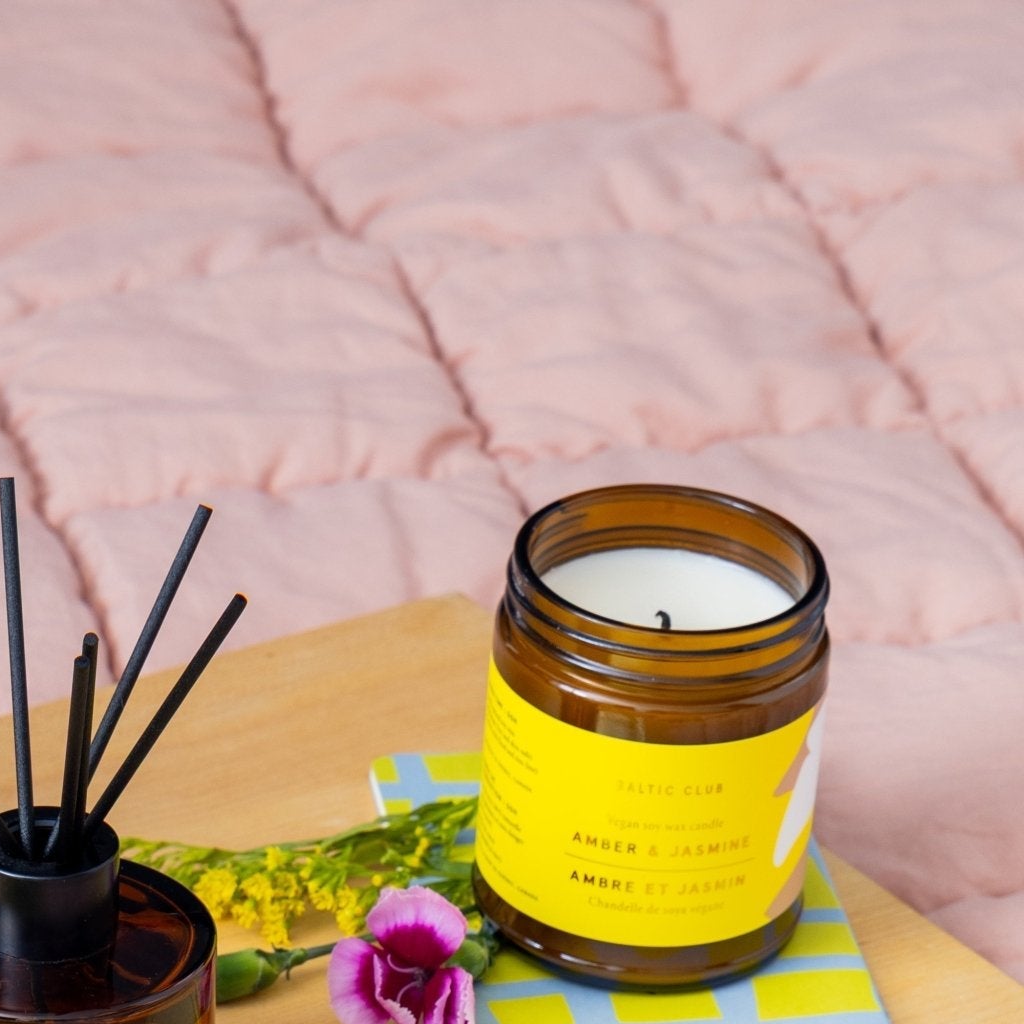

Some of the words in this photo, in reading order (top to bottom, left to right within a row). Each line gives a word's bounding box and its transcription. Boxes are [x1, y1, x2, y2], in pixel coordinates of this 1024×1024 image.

[684, 783, 724, 796] CLUB
[572, 831, 637, 855] AMBER
[648, 845, 659, 857] &
[669, 835, 751, 857] JASMINE
[569, 870, 634, 893] AMBRE
[645, 883, 669, 895] ET
[678, 874, 746, 896] JASMIN
